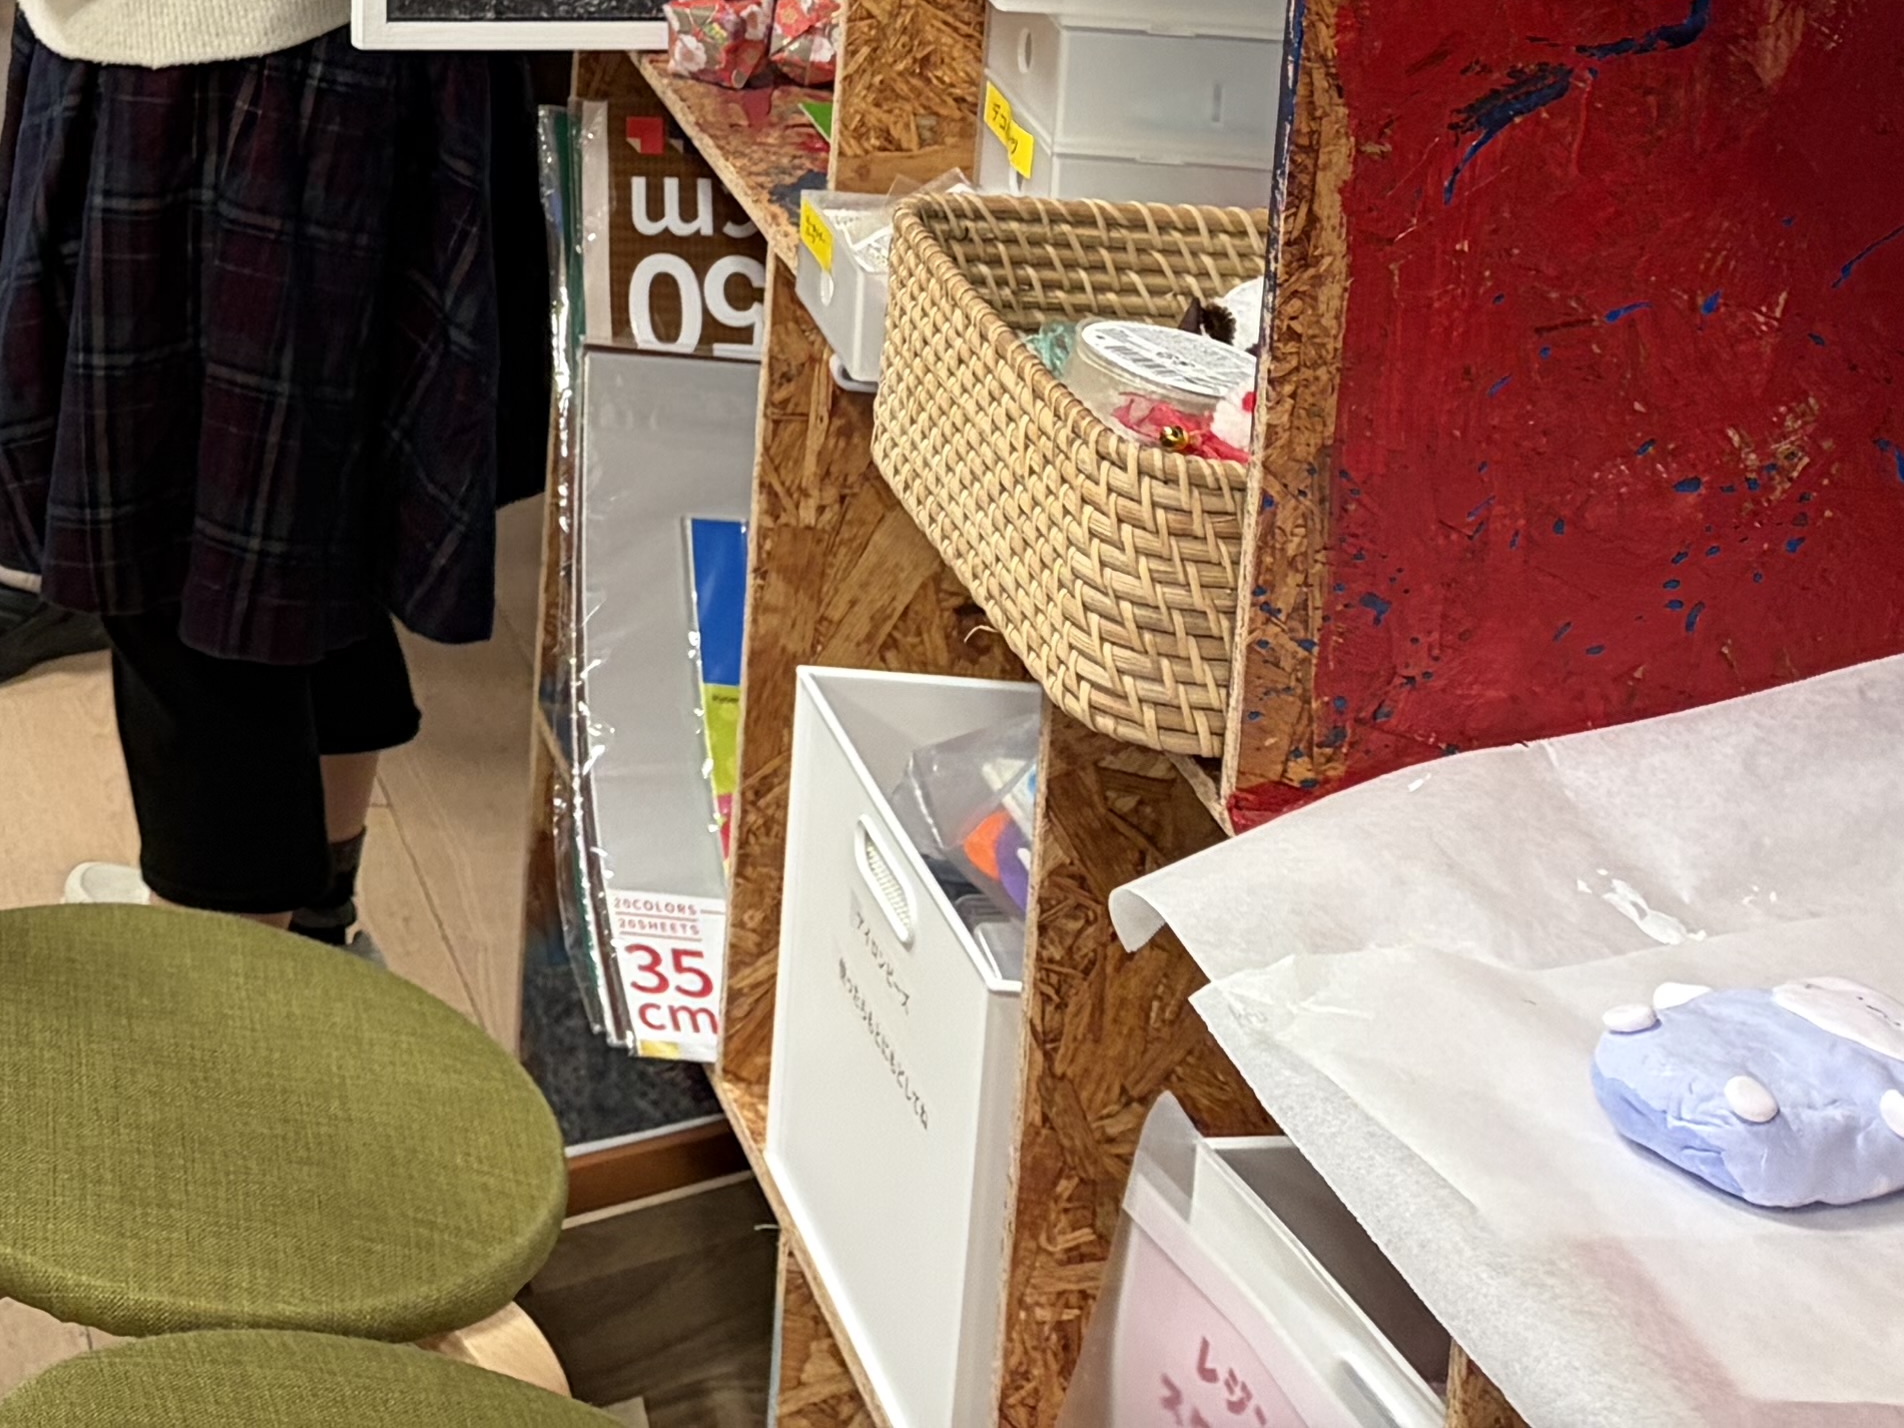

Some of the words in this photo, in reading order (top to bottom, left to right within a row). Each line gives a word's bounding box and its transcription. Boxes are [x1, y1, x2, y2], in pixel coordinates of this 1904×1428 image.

[629, 252, 765, 360] 50
[624, 943, 714, 999] 35
[856, 911, 910, 1017] アイロンビーズ
[638, 1002, 720, 1035] cm
